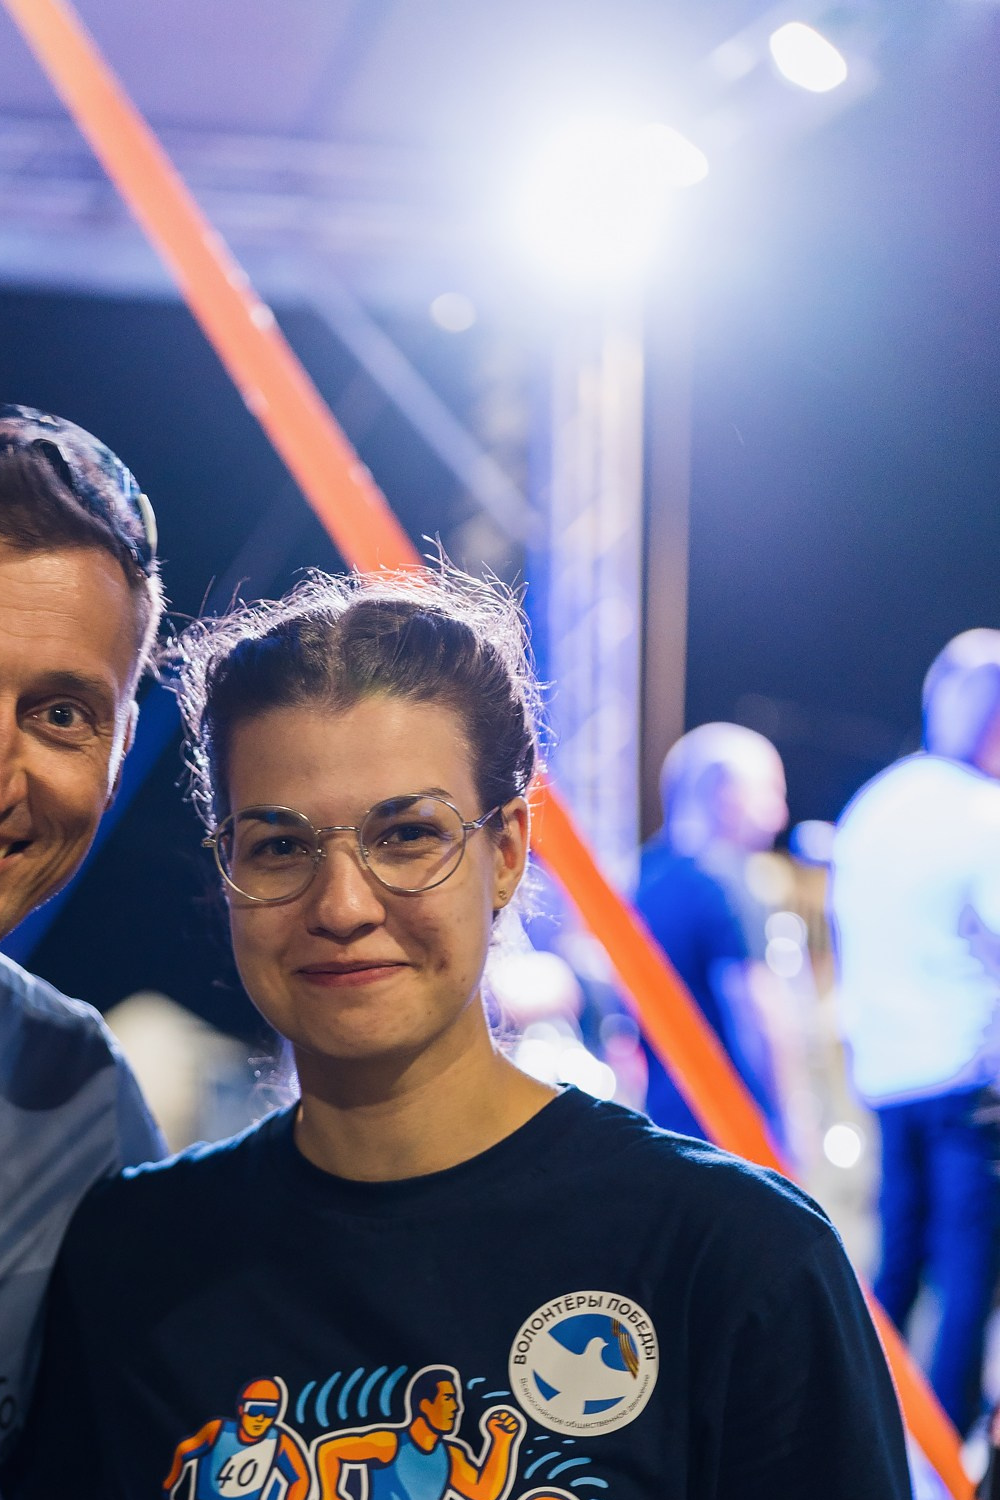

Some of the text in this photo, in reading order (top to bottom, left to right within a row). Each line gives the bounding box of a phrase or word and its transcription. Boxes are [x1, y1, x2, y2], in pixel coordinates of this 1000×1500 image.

[513, 1295, 656, 1365] ВОЛОНТЁРЫ ПОБЕДЫ
[215, 1456, 258, 1489] 40
